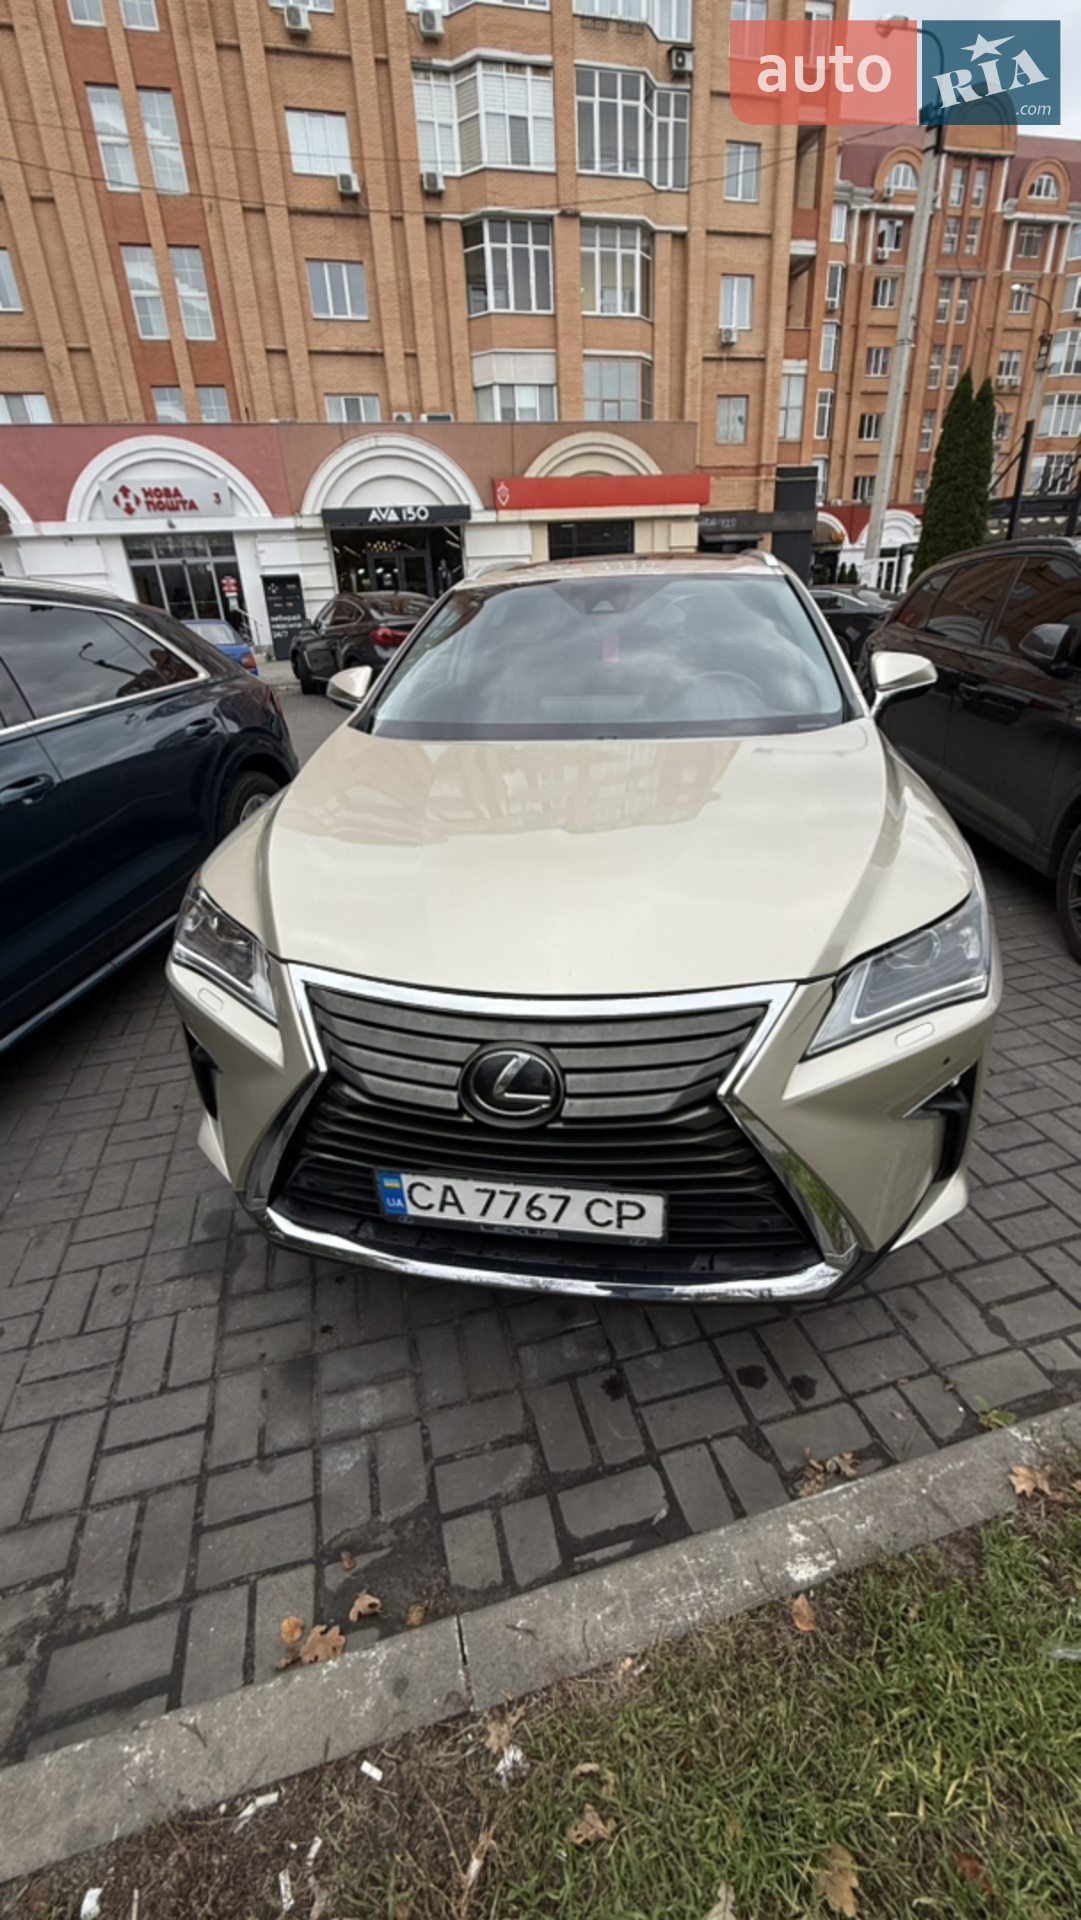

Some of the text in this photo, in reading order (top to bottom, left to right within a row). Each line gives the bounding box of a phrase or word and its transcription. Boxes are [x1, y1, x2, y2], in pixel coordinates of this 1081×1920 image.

[141, 486, 183, 499] НОВА
[213, 491, 222, 505] 3
[145, 499, 199, 512] ПОШТА
[387, 1197, 404, 1209] UA
[407, 1181, 646, 1229] CA 7767 CP
[479, 1224, 559, 1239] LEXUS
